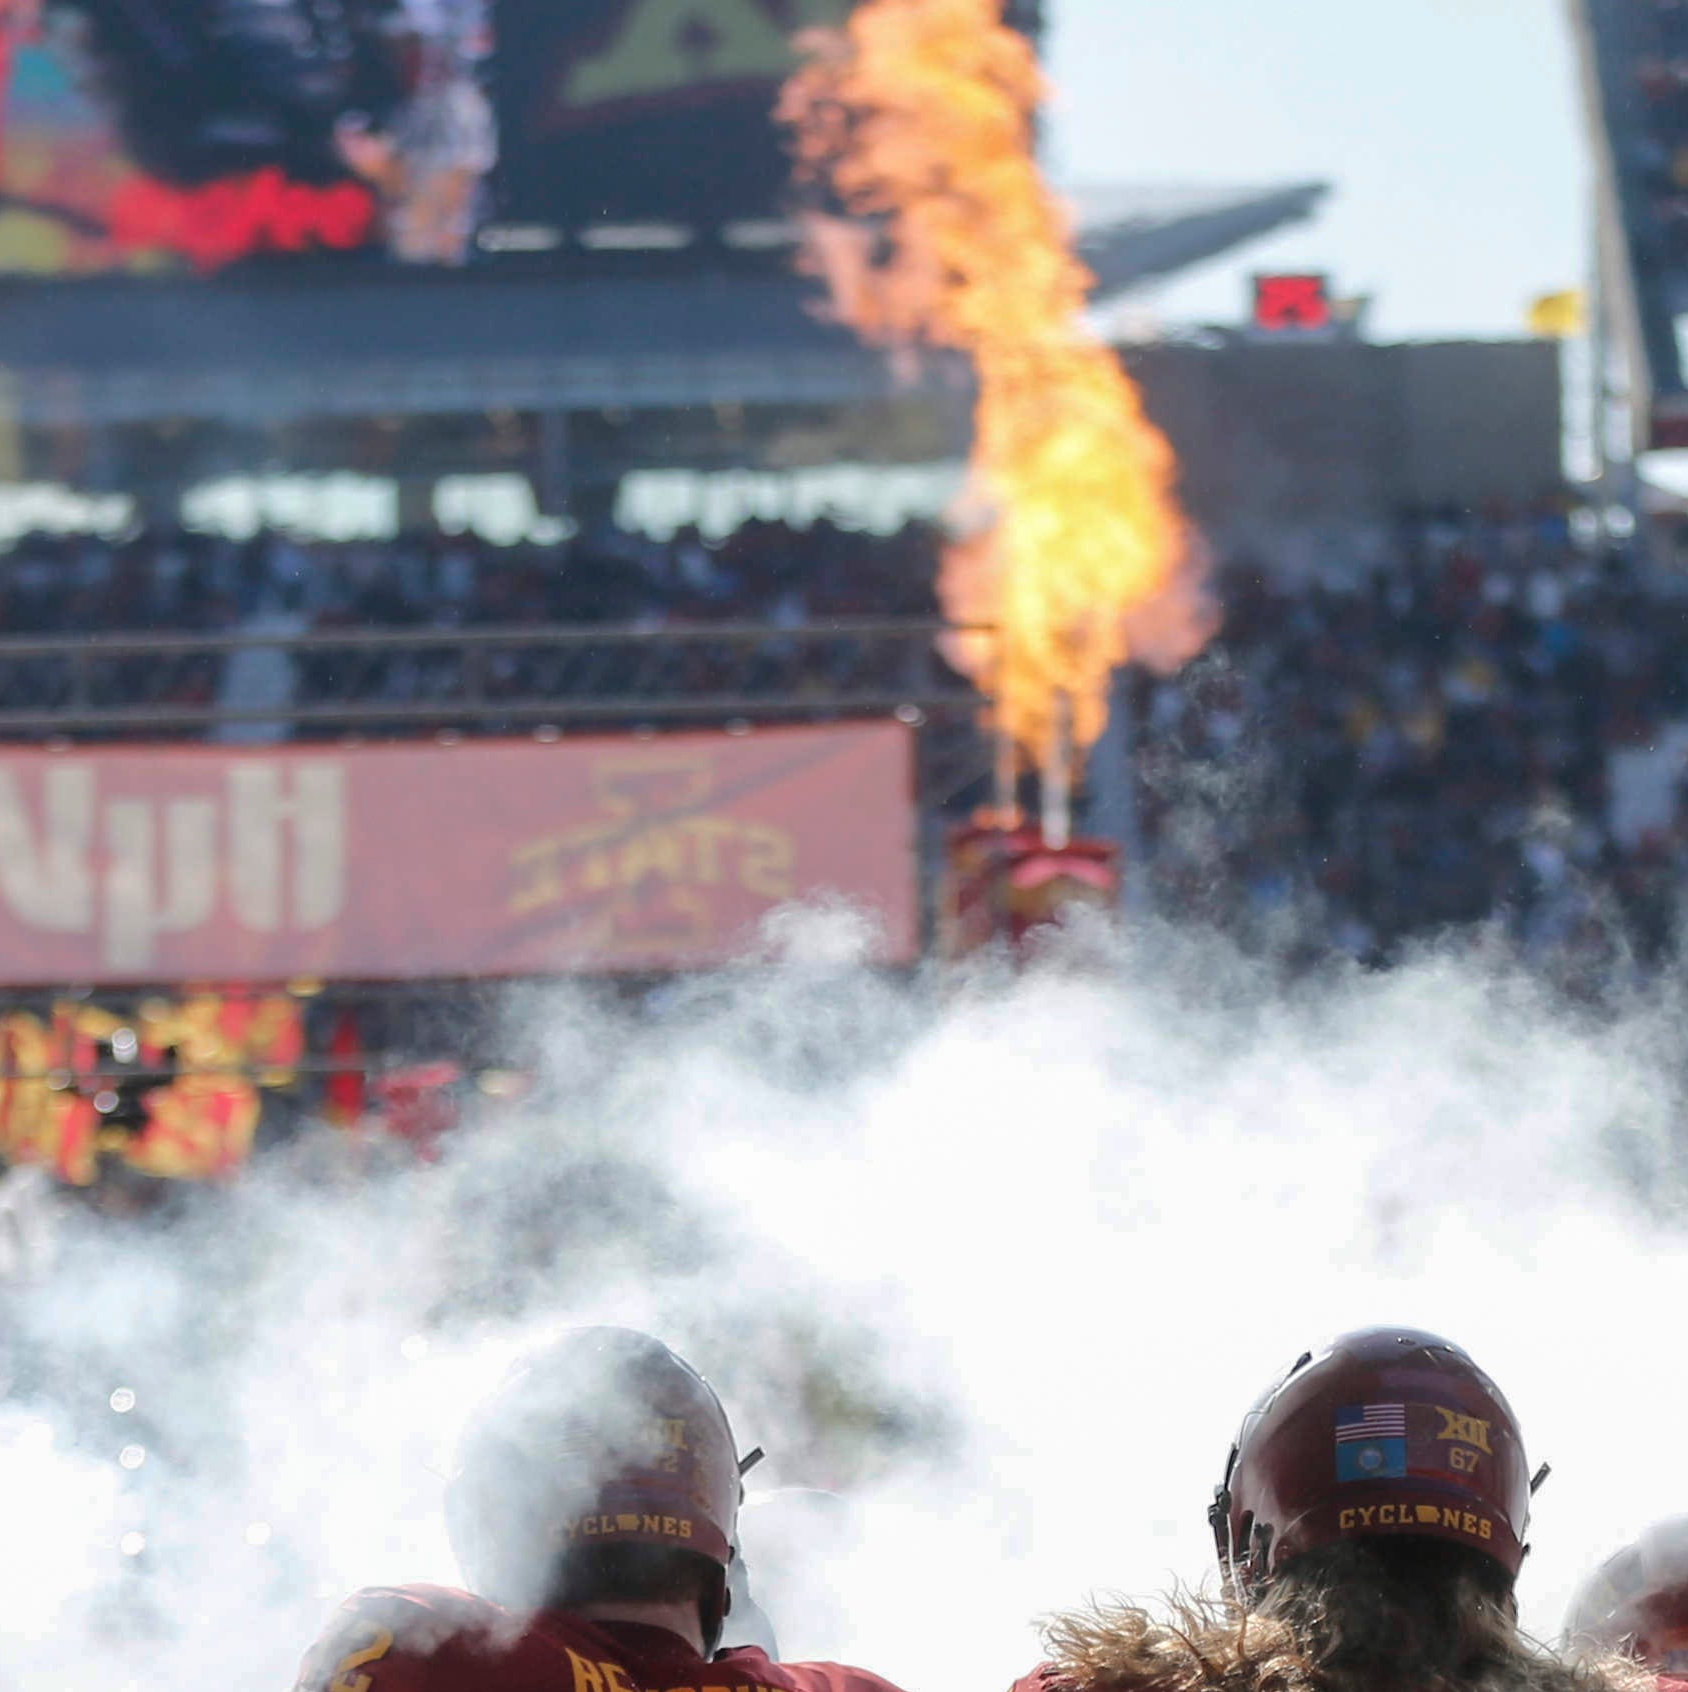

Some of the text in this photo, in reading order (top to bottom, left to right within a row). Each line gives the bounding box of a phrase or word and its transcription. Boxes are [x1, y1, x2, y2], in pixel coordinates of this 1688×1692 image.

[1449, 1449, 1479, 1473] 67
[548, 1512, 693, 1539] YCLONES
[1339, 1504, 1493, 1540] CYCLONES
